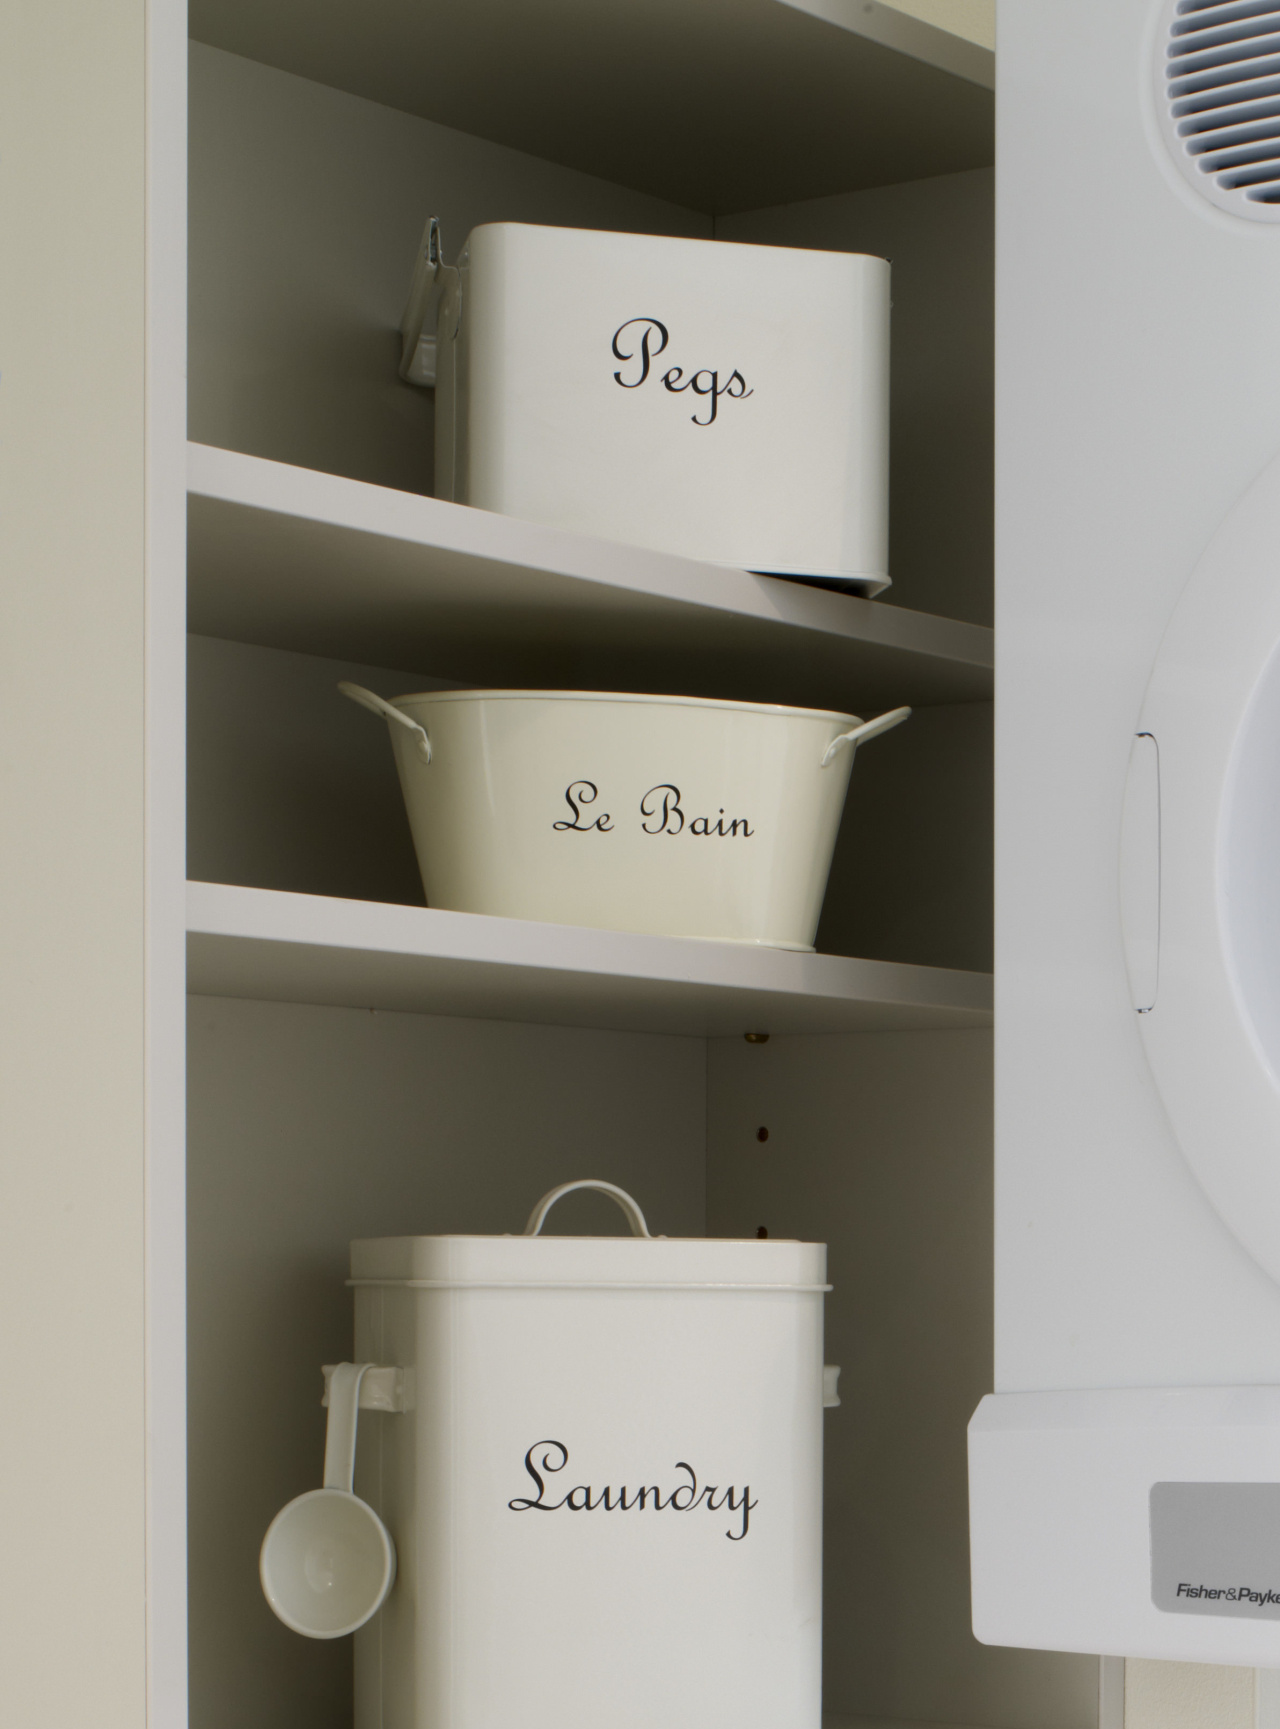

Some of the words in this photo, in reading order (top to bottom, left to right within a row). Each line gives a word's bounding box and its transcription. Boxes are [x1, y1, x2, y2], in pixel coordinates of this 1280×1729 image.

[611, 317, 754, 426] Pegs
[552, 780, 615, 832] Le
[640, 783, 755, 837] Bain
[508, 1440, 759, 1541] Laundry
